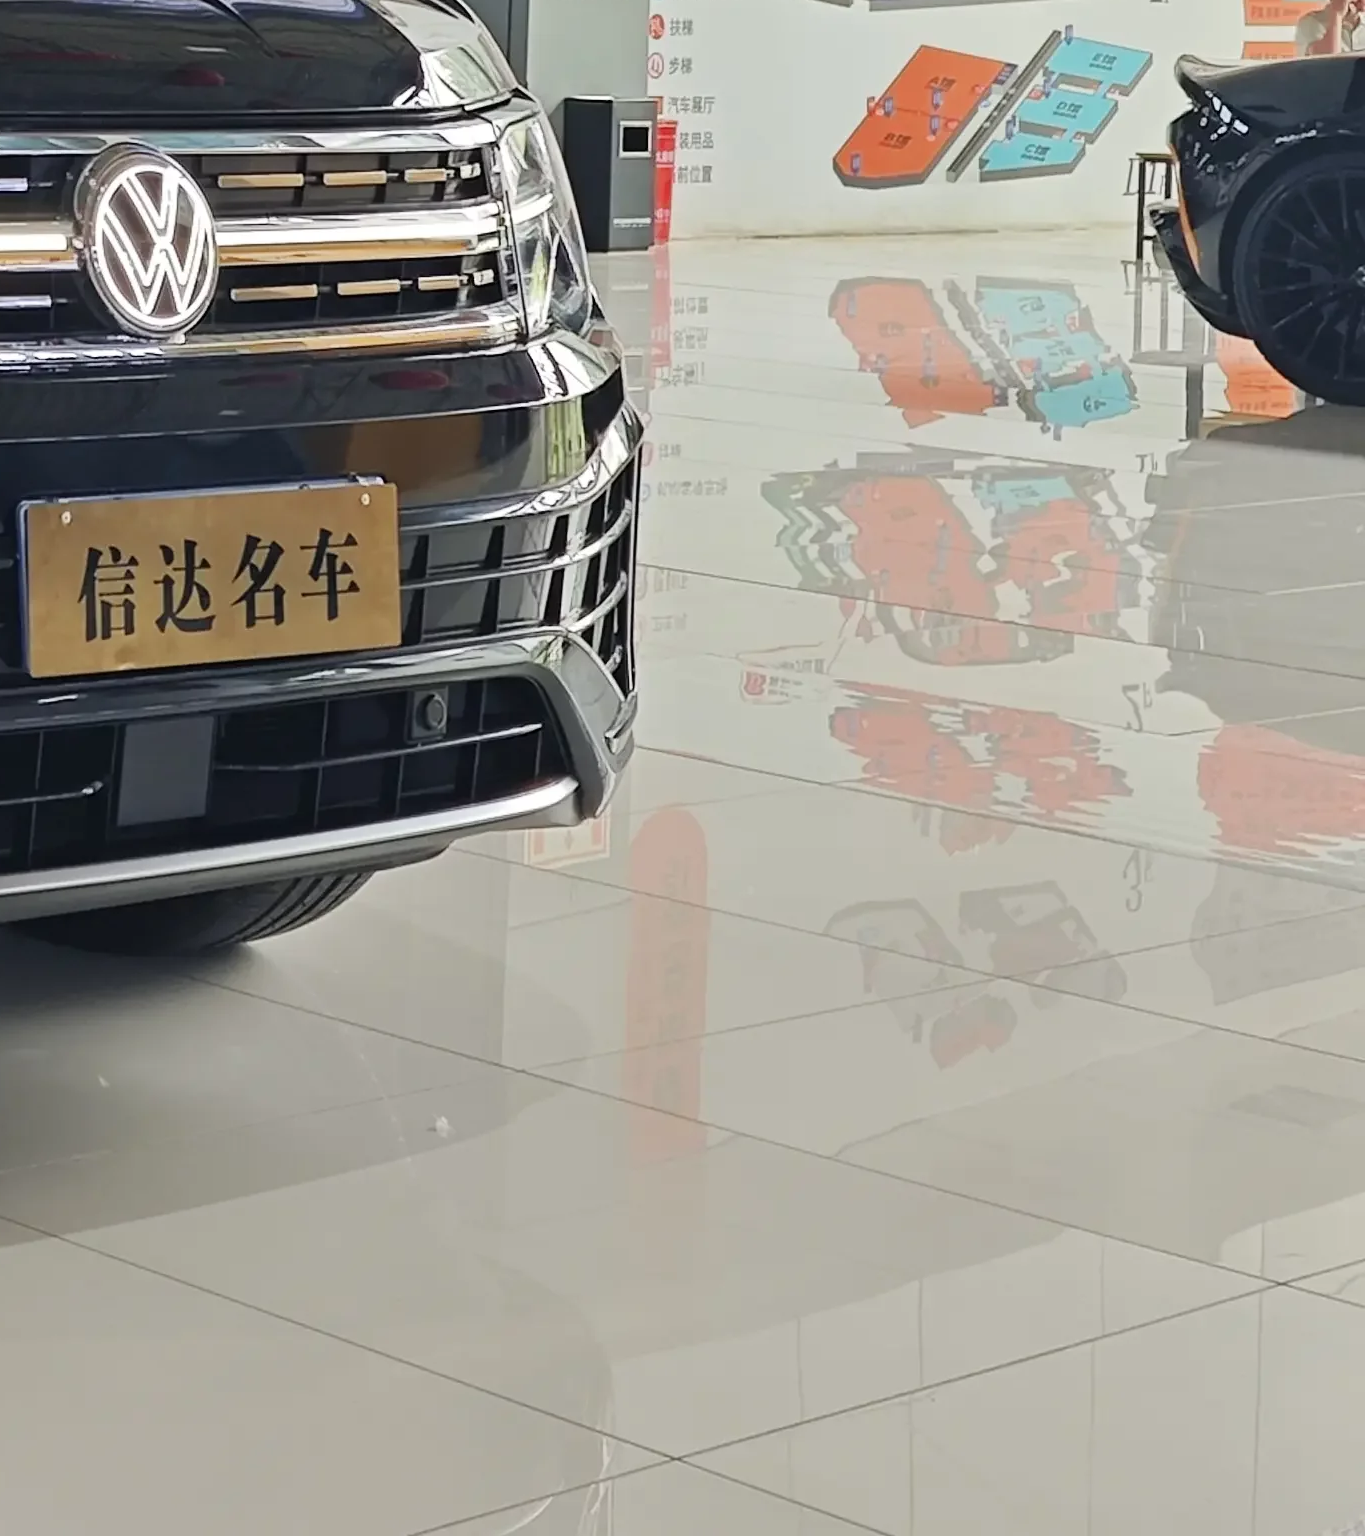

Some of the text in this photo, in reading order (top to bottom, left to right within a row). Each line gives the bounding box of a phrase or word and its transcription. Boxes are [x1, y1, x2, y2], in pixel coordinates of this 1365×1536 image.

[669, 57, 693, 75] 步梯
[668, 95, 715, 114] 汽车展厅
[678, 131, 715, 151] 装用品
[673, 164, 713, 184] 前位置
[77, 527, 361, 643] 信达名车
